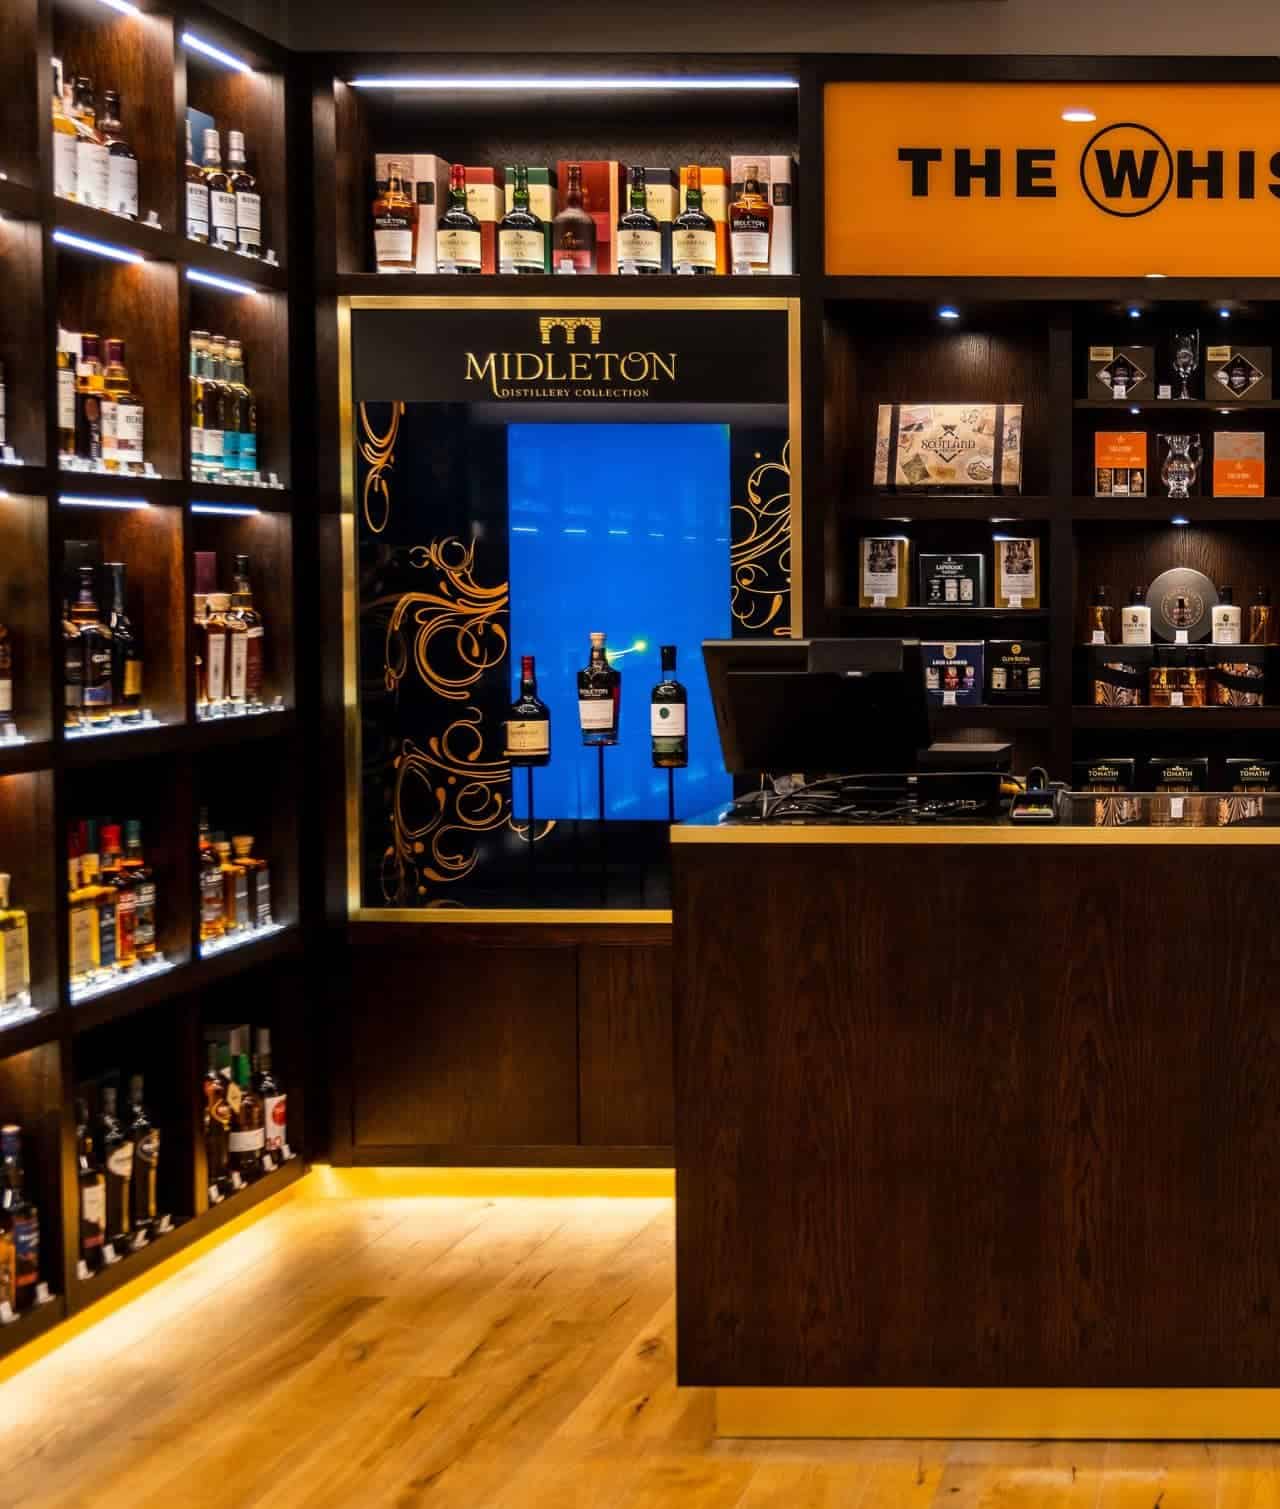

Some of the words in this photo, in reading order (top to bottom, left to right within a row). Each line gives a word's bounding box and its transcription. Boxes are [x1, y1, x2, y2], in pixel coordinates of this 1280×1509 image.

[898, 148, 1057, 198] THE
[464, 352, 678, 398] MIDLETON
[502, 388, 569, 397] DISTILLERY
[575, 388, 649, 397] COLLECTION
